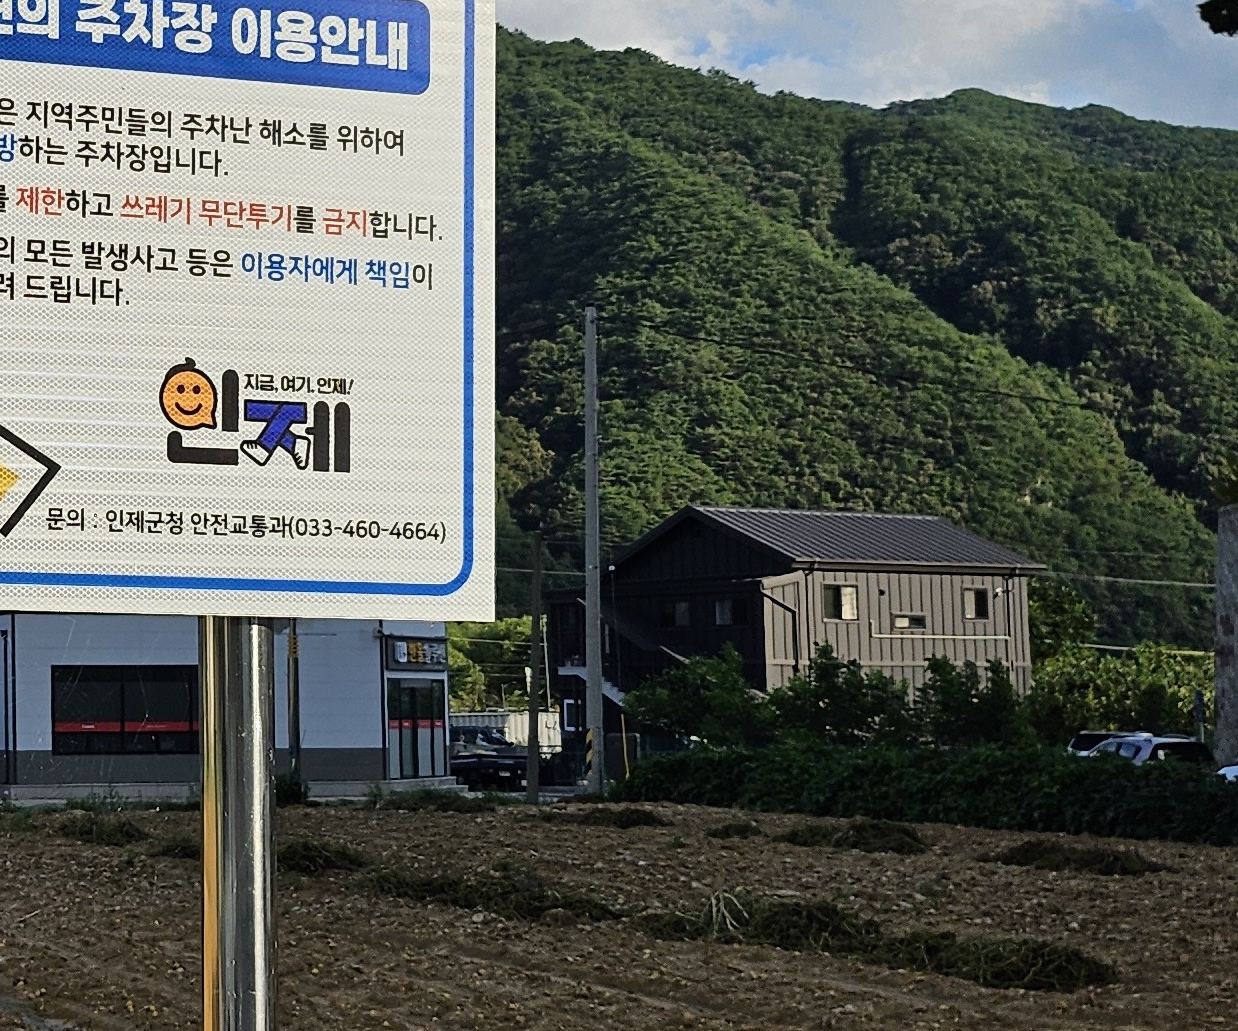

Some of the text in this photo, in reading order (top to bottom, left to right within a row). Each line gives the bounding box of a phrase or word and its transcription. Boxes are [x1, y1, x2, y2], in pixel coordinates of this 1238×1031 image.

[231, 7, 408, 71] 이용안내
[25, 100, 172, 140] 지역주민들의
[180, 112, 253, 145] 주차난
[259, 118, 330, 151] 해소를
[336, 125, 405, 157] 위하여
[74, 139, 230, 177] 주차장입니다.
[15, 186, 114, 219] 제한하고
[119, 194, 192, 225] 쓰레기
[198, 199, 317, 235] 무단투기를
[322, 207, 444, 243] 금지합니다.
[23, 239, 74, 268] 모든
[81, 241, 179, 273] 발생사고
[185, 248, 234, 278] 등은
[241, 251, 359, 287] 이용자에게
[364, 258, 434, 291] 책임이
[23, 274, 131, 307] 드립니다.
[45, 507, 85, 532] 문의
[105, 509, 184, 536] 인제군청
[190, 512, 448, 544] 안전교통과(033-460-4664)
